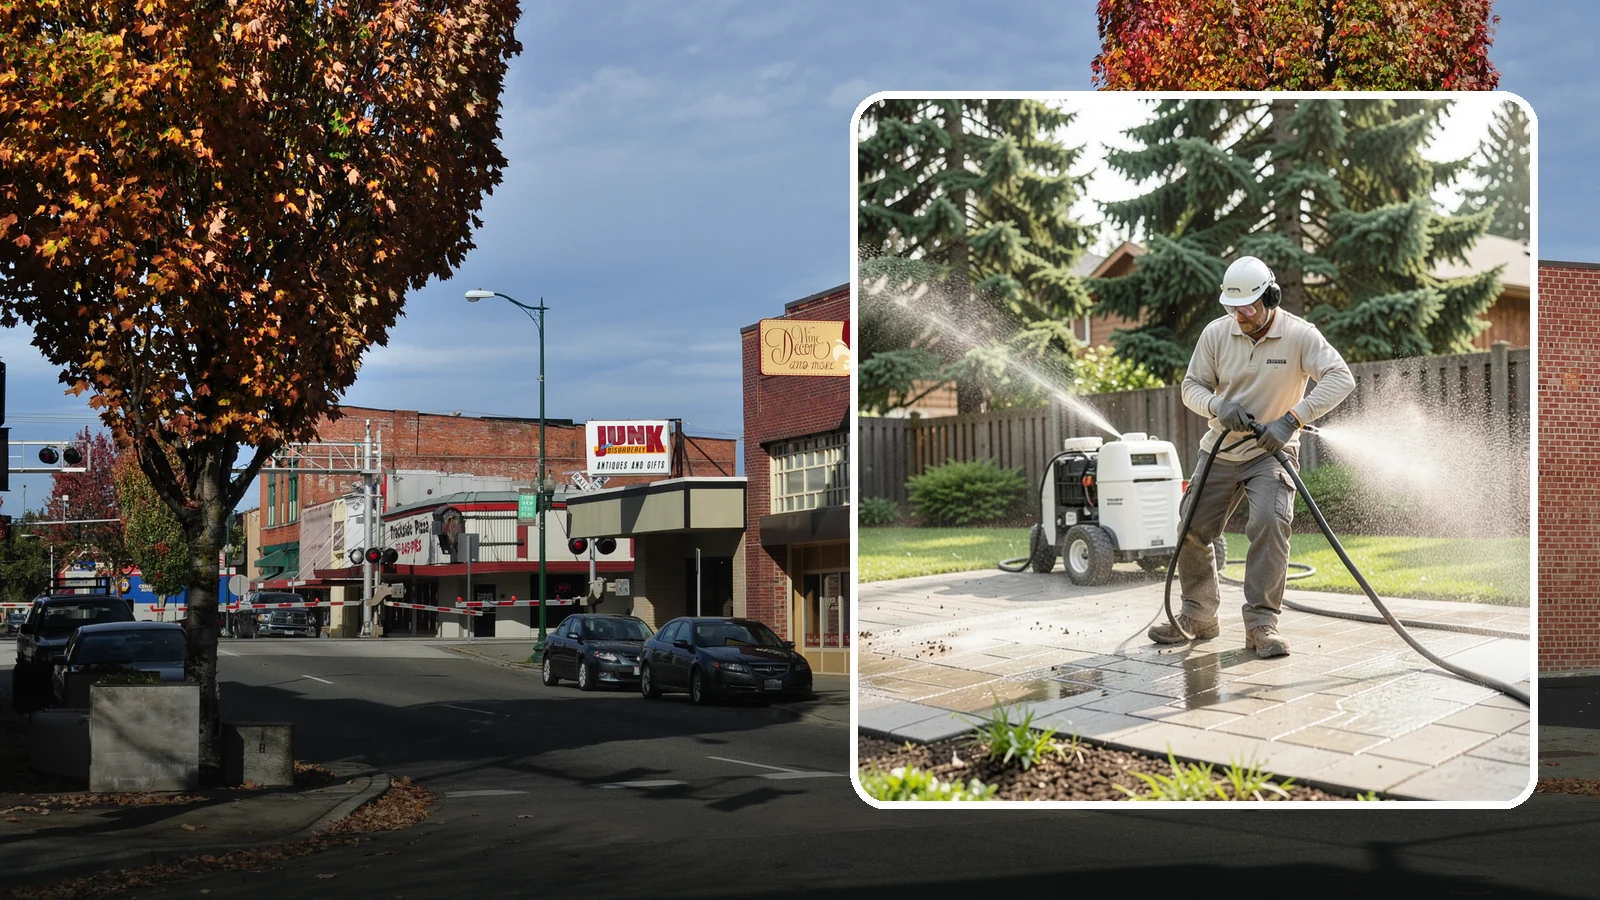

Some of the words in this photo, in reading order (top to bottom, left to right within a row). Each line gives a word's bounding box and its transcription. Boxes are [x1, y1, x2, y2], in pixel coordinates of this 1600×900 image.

[595, 425, 665, 457] JUNK
[607, 446, 646, 454] DISORDERLY
[596, 461, 628, 470] ANTIQUES
[631, 461, 644, 470] AND
[647, 460, 665, 469] GIFTS
